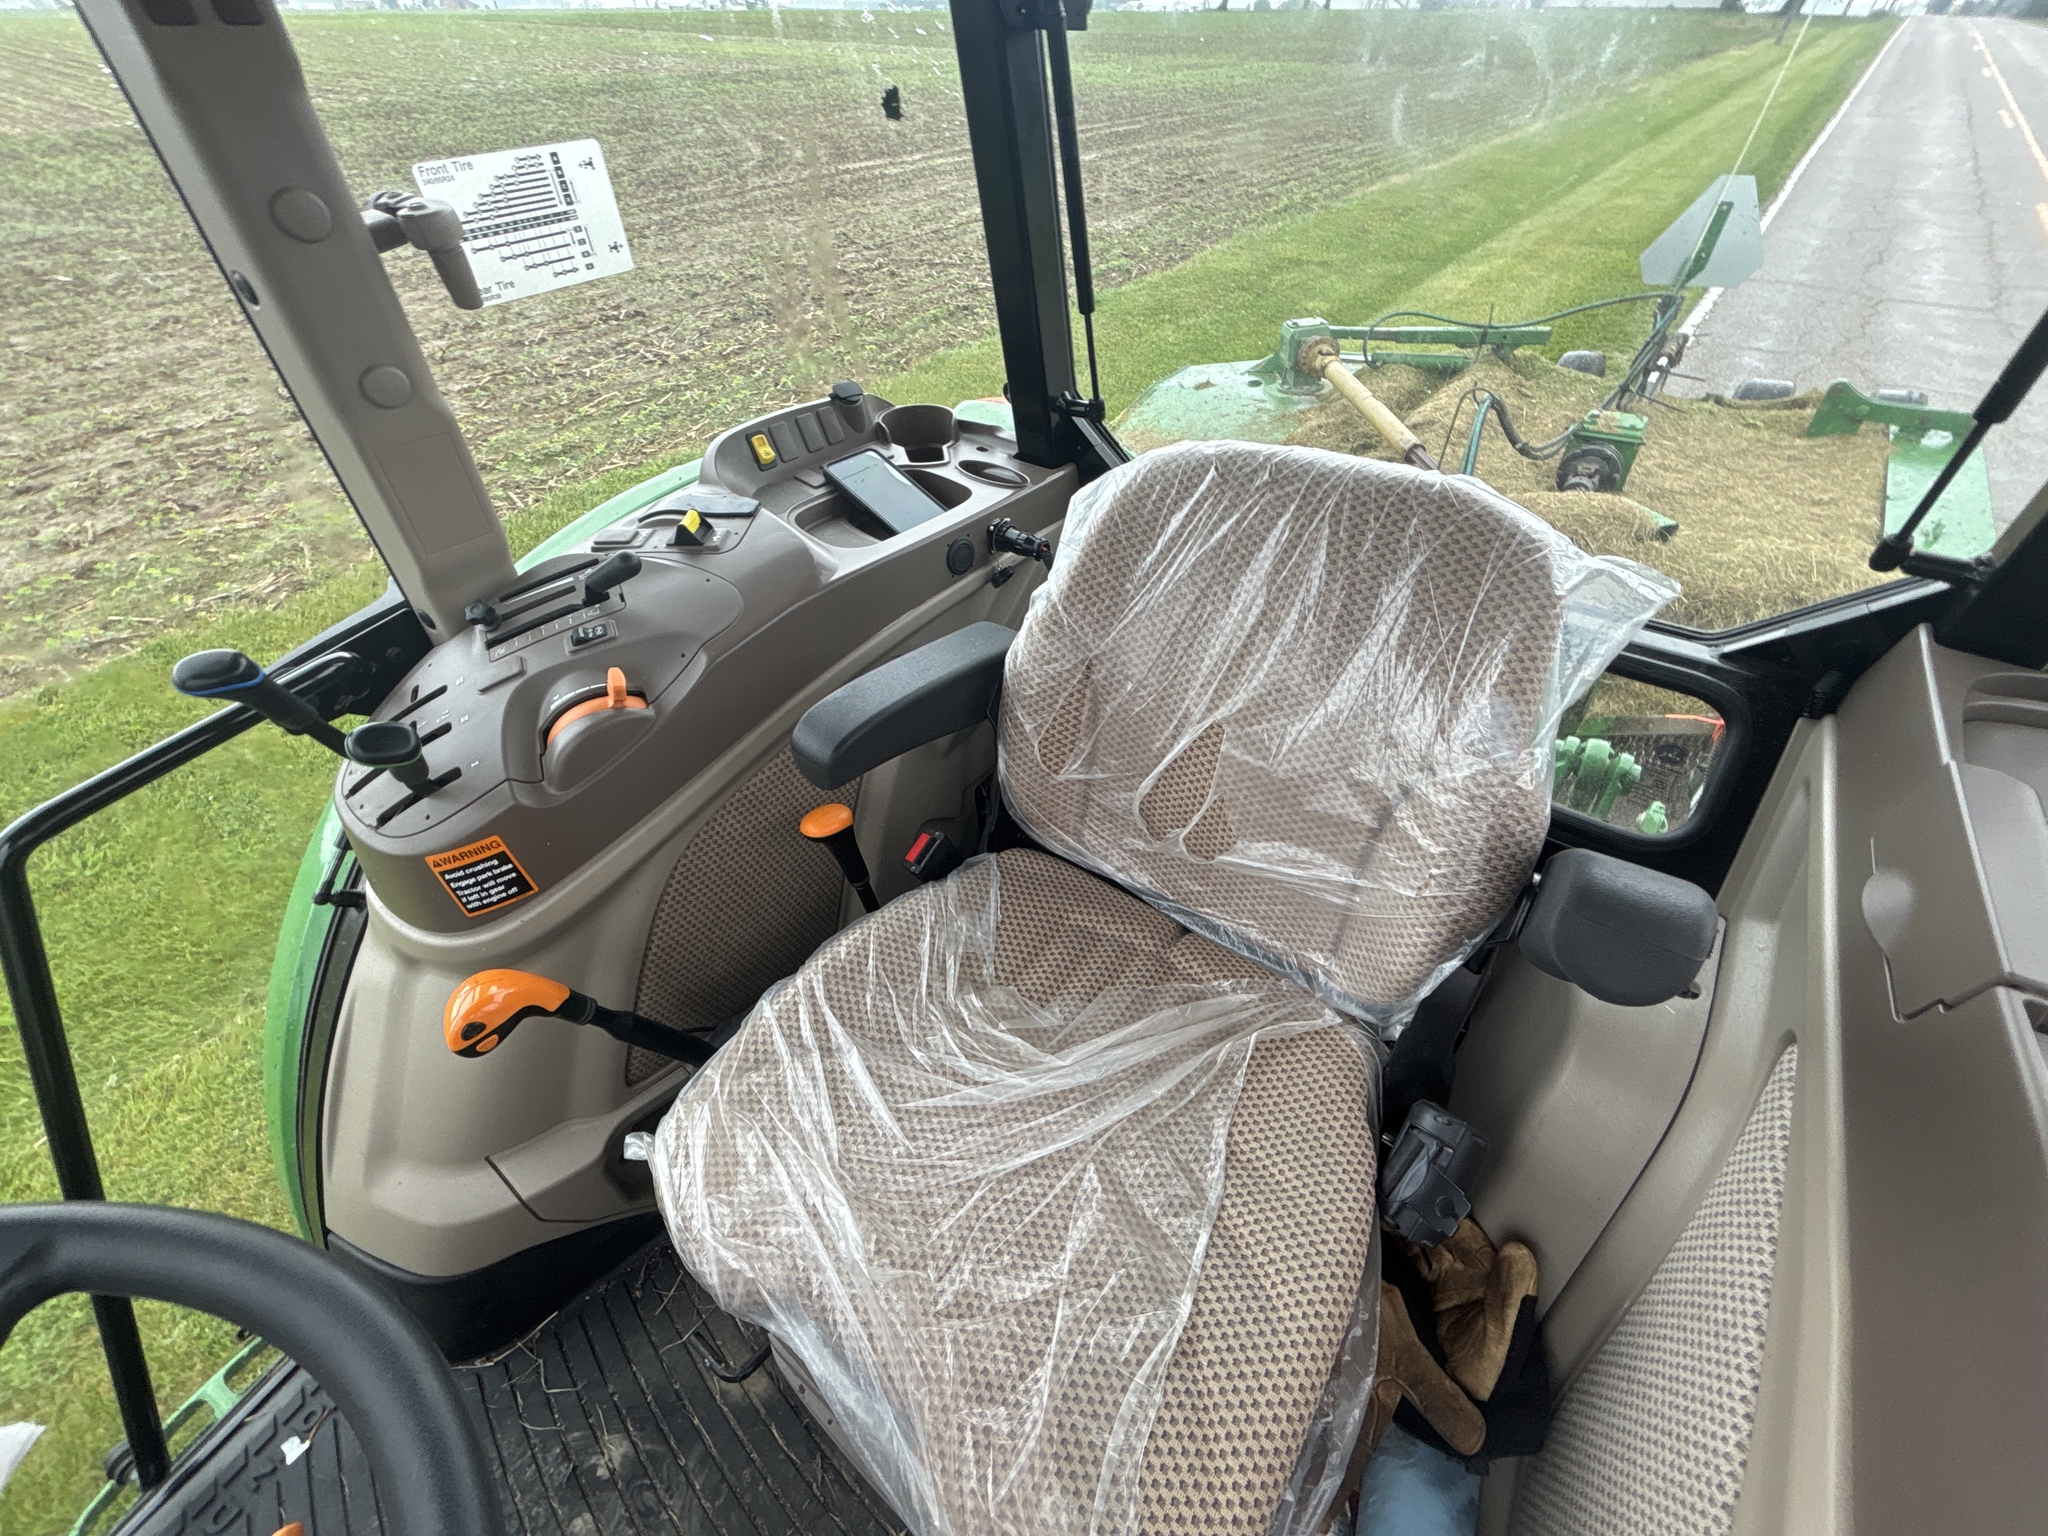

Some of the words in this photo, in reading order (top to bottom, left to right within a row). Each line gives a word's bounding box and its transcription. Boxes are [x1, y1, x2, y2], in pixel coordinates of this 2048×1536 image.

[417, 163, 449, 177] Front
[451, 161, 474, 172] Tire
[478, 286, 493, 295] ear
[495, 280, 516, 292] Tire
[439, 840, 502, 865] WARNING
[444, 869, 465, 881] Avoid
[465, 859, 499, 875] crushing
[449, 877, 477, 889] Engage
[476, 871, 494, 882] park
[492, 863, 514, 875] brake
[455, 885, 482, 897] Tractor
[482, 880, 496, 889] will
[496, 872, 517, 885] move
[467, 892, 480, 901] left
[480, 889, 489, 897] in
[489, 884, 505, 895] gear
[466, 901, 482, 909] with
[482, 892, 507, 903] engine
[507, 886, 519, 896] off
